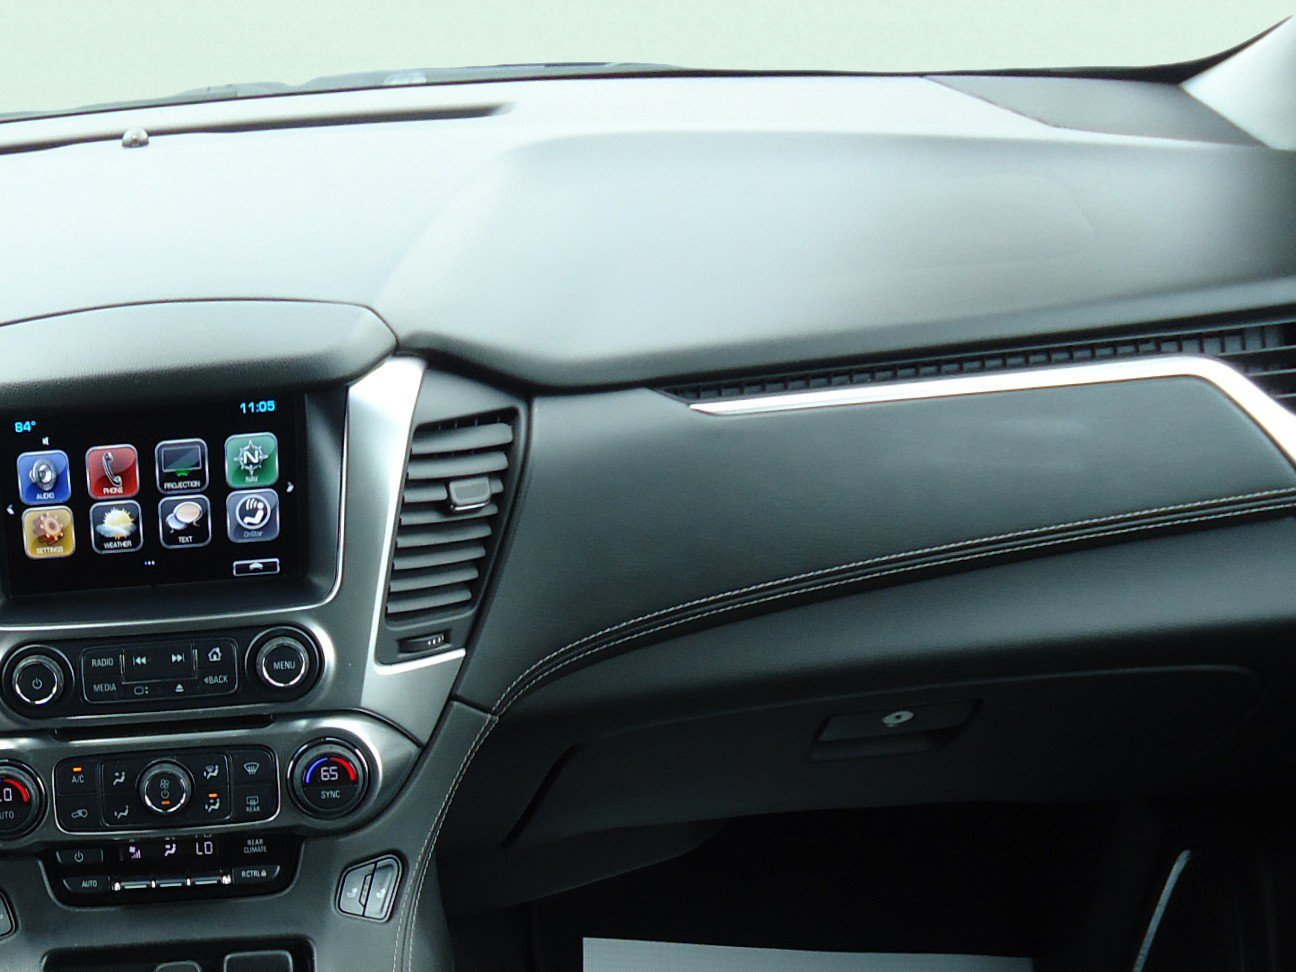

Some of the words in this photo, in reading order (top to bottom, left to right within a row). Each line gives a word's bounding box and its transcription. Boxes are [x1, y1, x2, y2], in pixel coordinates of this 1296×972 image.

[240, 400, 275, 414] 11:05
[14, 420, 36, 433] 84°
[164, 480, 201, 490] PROJECTION
[103, 487, 123, 495] PHONE
[36, 492, 54, 500] AUDIO
[104, 540, 132, 549] WEATHER
[36, 546, 64, 554] SETTINGS
[92, 657, 114, 667] RADIO
[273, 661, 296, 670] MENU
[208, 675, 228, 684] BACK
[94, 684, 116, 693] MEDIA
[320, 766, 339, 781] 65
[72, 774, 84, 783] A/C
[321, 790, 340, 798] SYNC
[247, 838, 264, 846] REAR
[195, 841, 213, 855] LO
[243, 846, 267, 854] CLIMATE
[81, 880, 97, 888] AUTO
